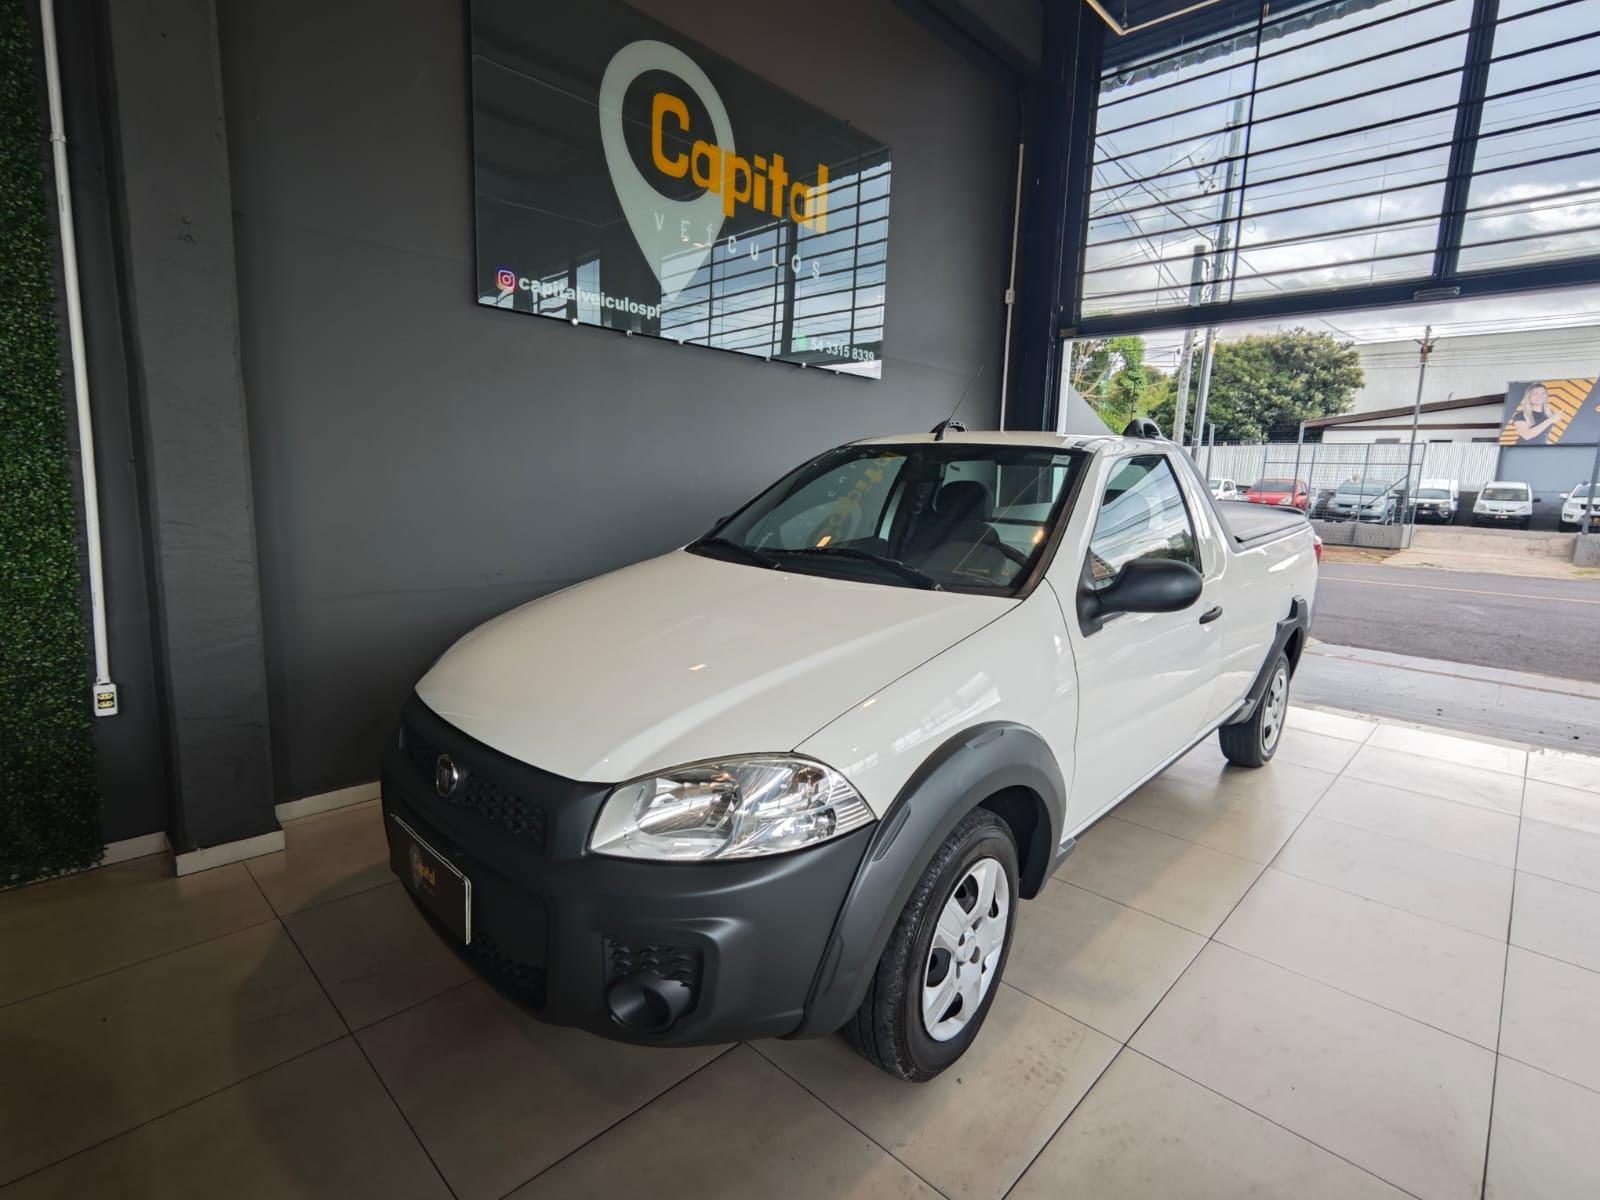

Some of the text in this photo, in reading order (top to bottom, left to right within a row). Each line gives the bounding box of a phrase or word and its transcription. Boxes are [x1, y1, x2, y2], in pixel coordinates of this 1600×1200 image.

[651, 92, 829, 234] Capital
[518, 276, 662, 320] capitalveiculospf
[826, 342, 850, 359] 3315
[852, 347, 875, 362] 8339
